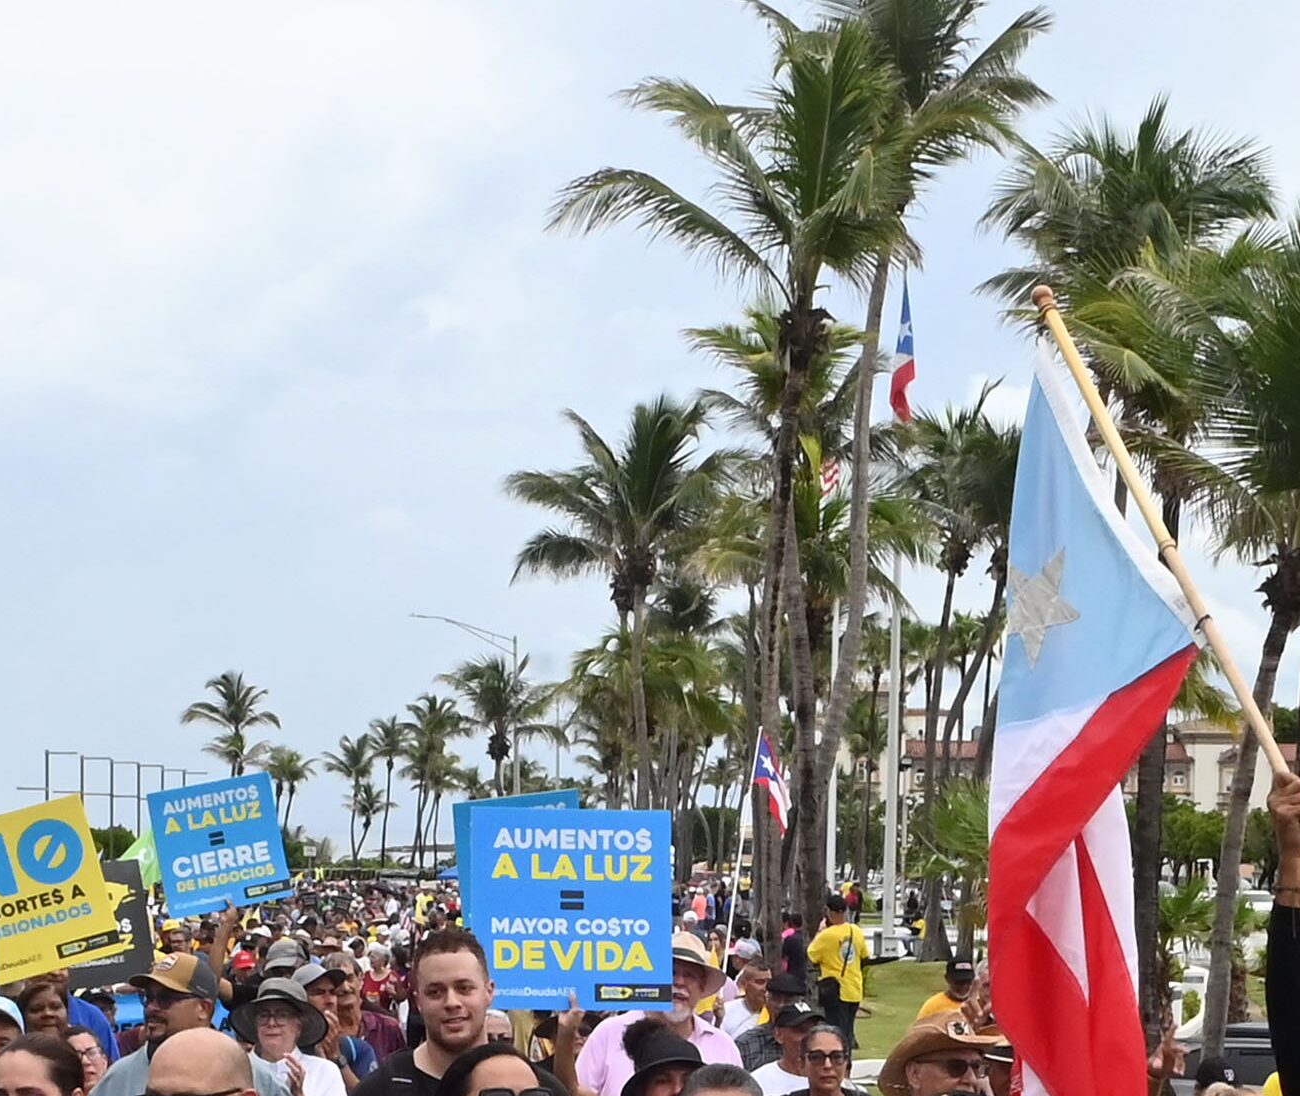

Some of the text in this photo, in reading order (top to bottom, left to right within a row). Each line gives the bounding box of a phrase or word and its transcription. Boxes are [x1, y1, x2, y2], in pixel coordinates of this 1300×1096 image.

[164, 800, 262, 835] A LA LUZ
[172, 840, 271, 878] CIERRE
[491, 853, 653, 882] A LA LUZ
[71, 884, 86, 900] A
[176, 880, 197, 893] DE
[490, 917, 569, 935] MAYOR
[492, 939, 654, 971] DE VIDA
